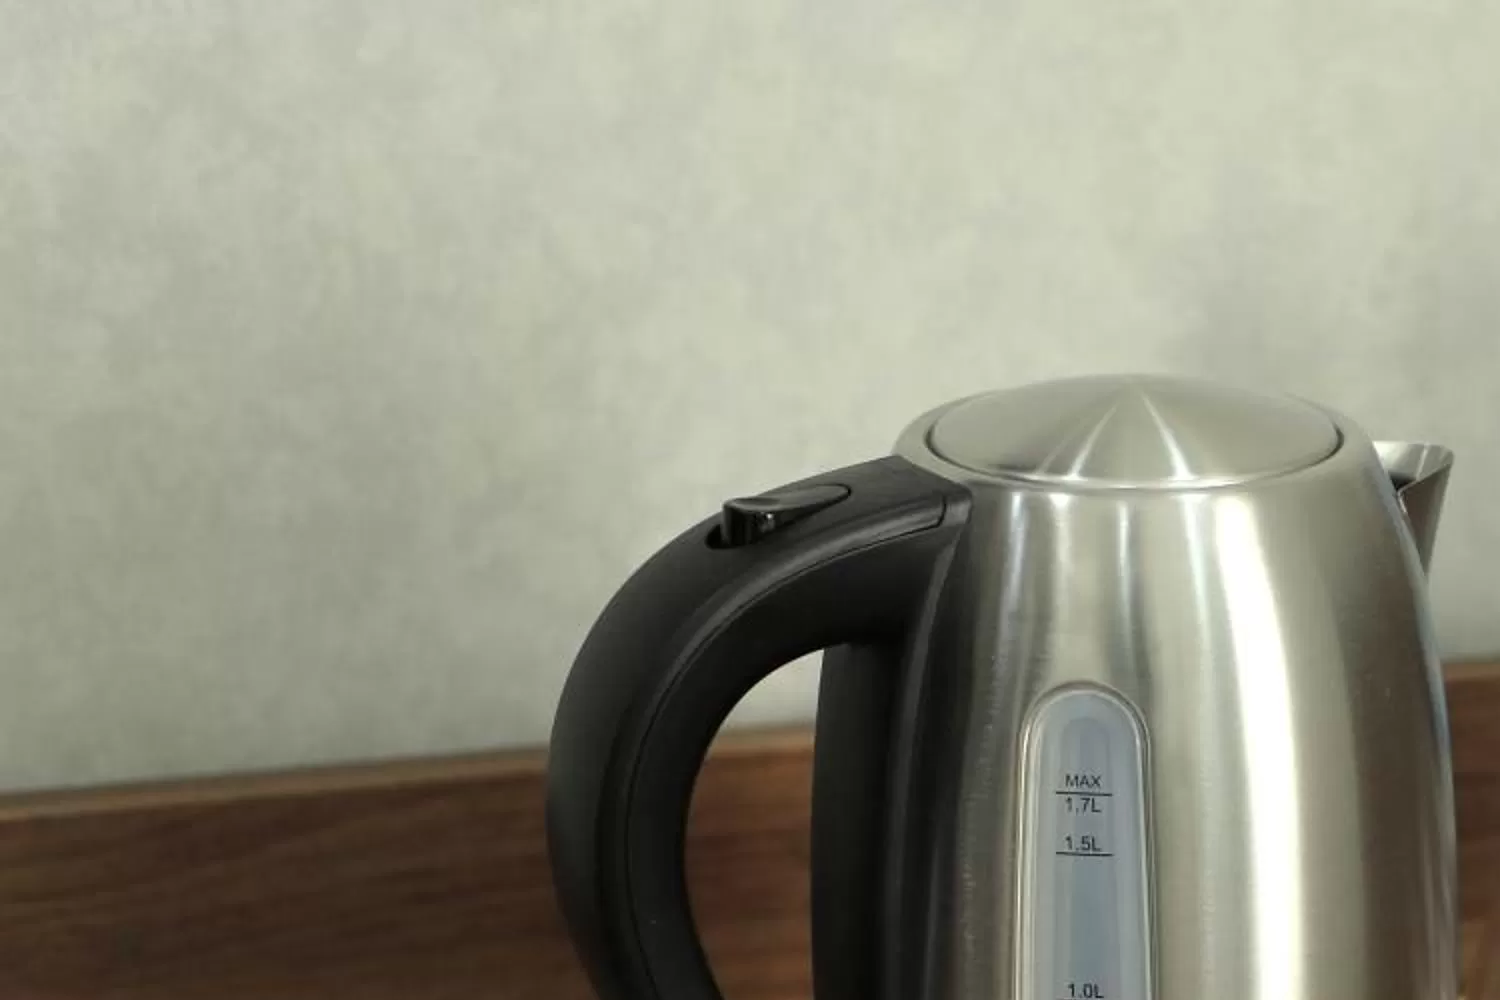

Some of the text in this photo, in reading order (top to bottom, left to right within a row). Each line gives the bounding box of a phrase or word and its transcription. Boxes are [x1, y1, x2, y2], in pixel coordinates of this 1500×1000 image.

[1065, 774, 1101, 788] MAX
[1065, 797, 1102, 814] 1.7L
[1065, 835, 1102, 852] 1.5L
[1068, 983, 1104, 999] 1.0L
